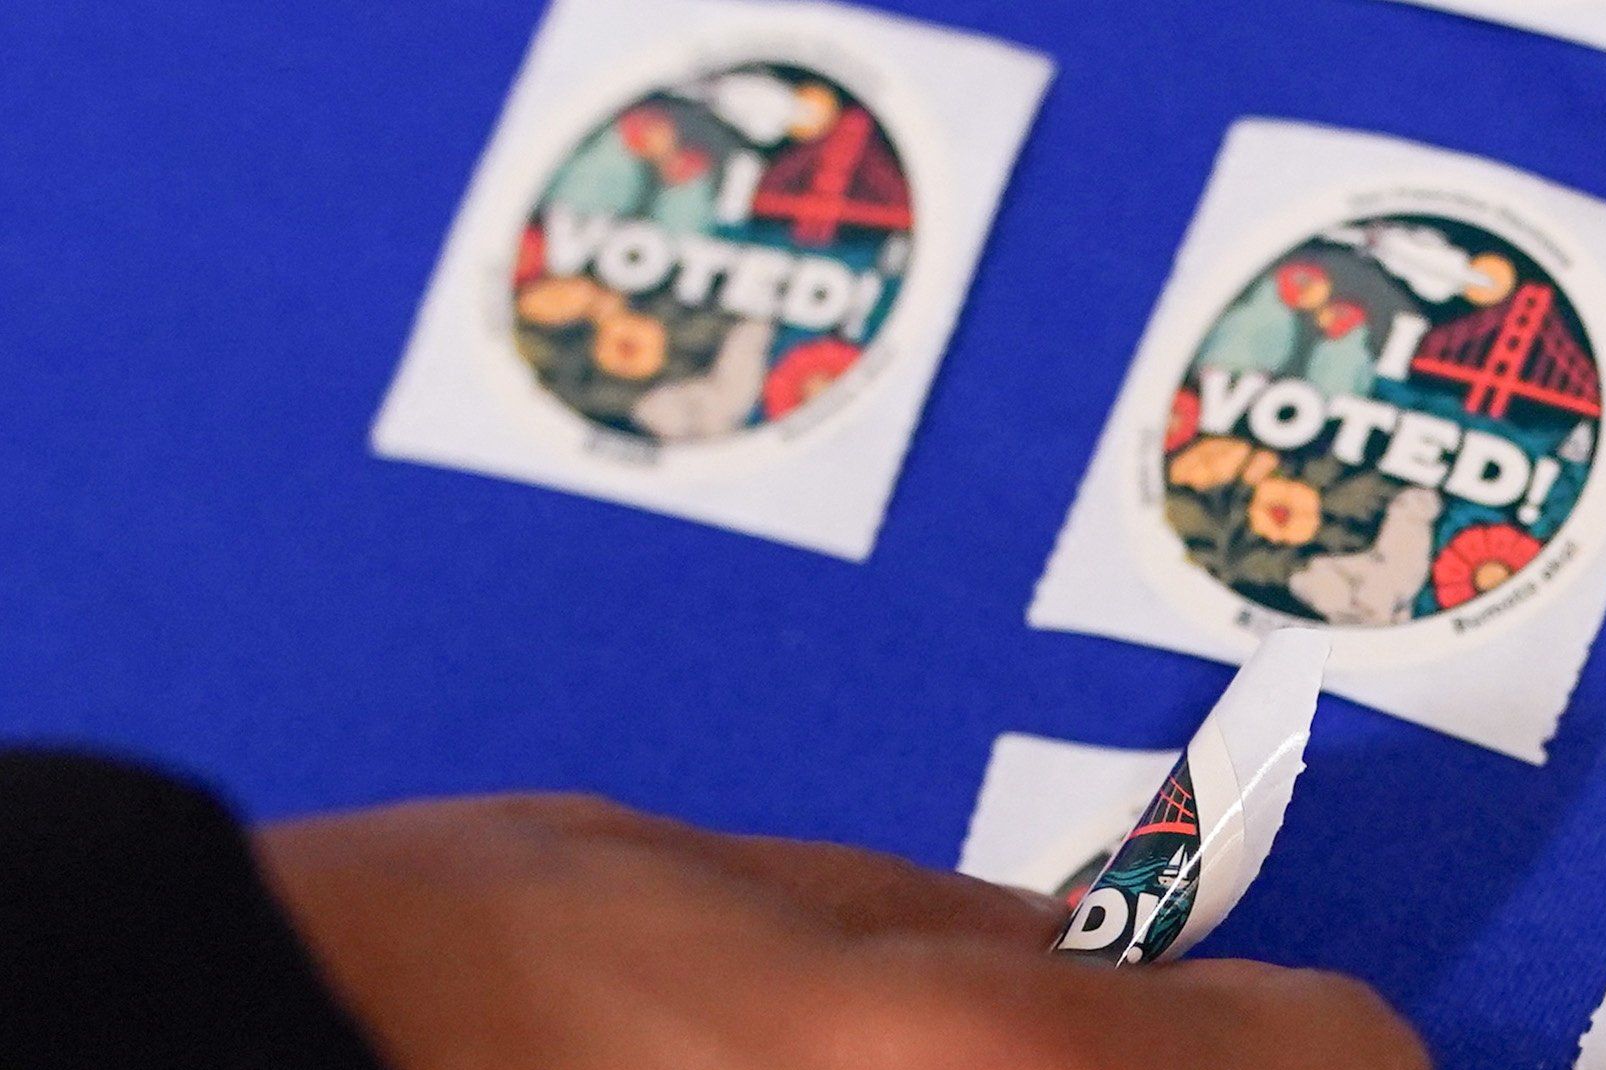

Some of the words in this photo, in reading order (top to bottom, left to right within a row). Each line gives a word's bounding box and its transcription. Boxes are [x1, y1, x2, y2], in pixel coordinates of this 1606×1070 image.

[718, 152, 763, 226] I
[543, 210, 886, 340] VOTED!
[1377, 313, 1431, 381] I
[1199, 369, 1562, 524] VOTED!
